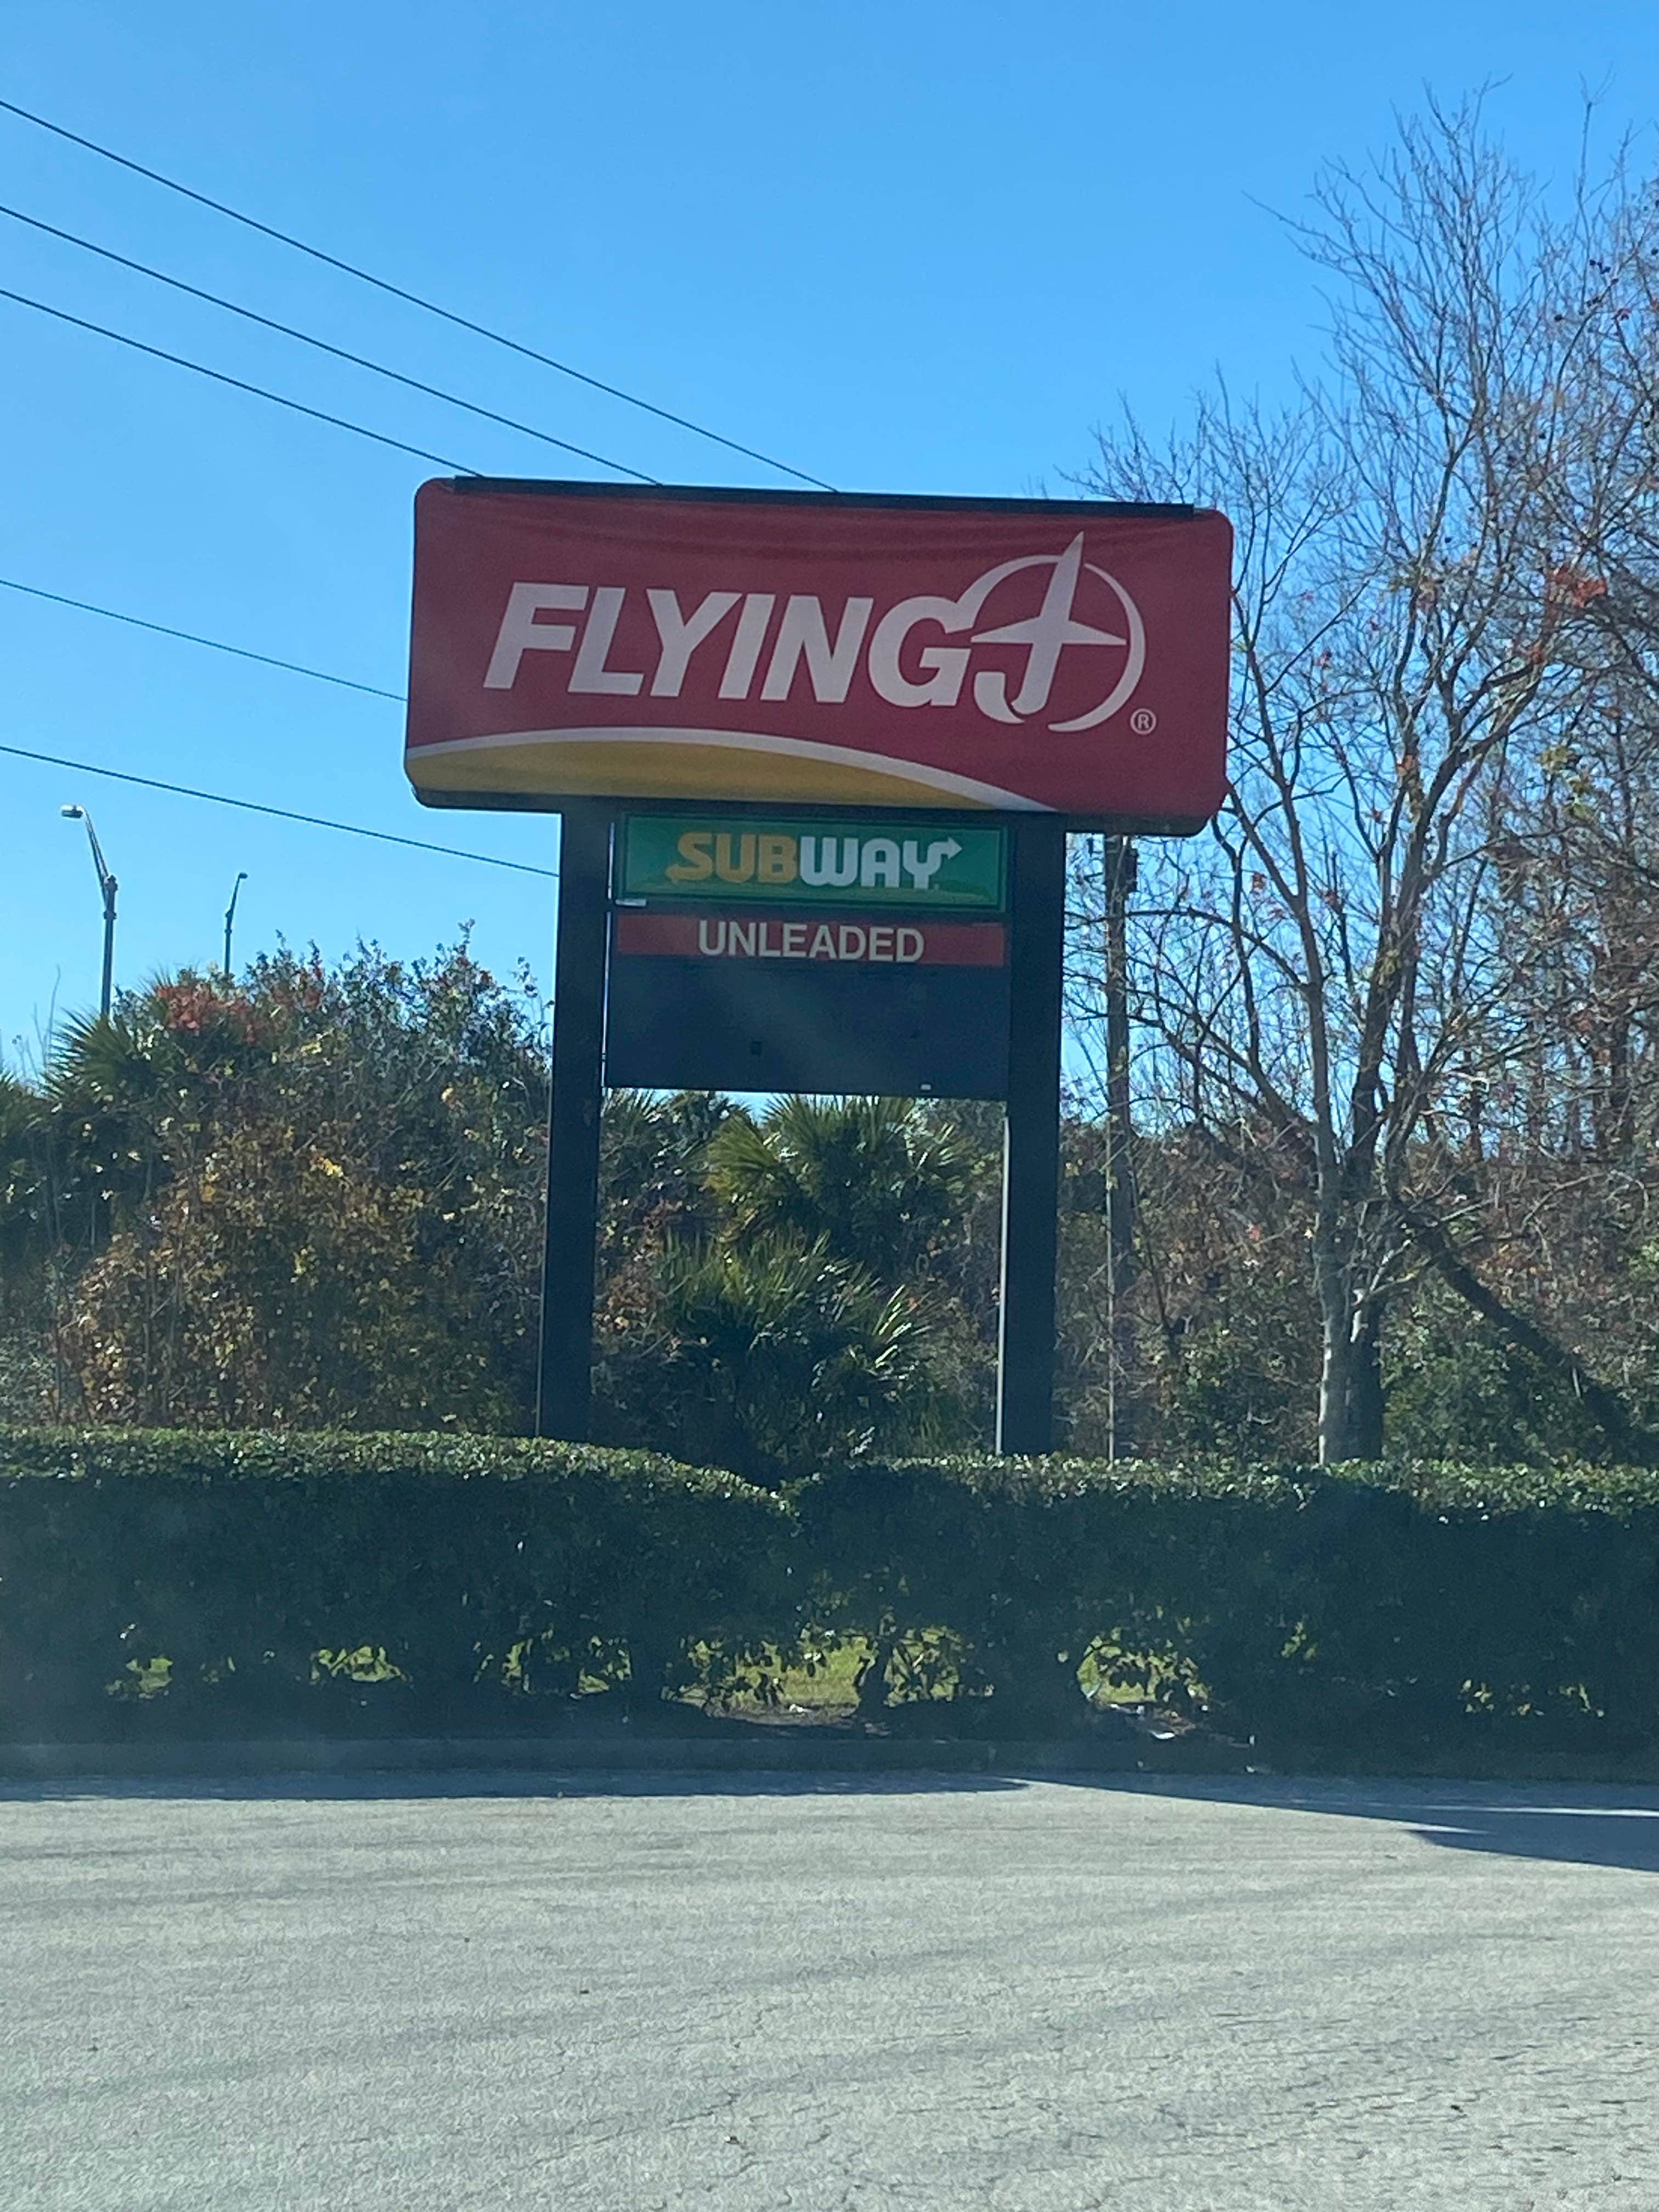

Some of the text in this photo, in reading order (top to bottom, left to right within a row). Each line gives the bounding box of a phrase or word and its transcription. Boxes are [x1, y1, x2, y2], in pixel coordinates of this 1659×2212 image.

[483, 582, 973, 708] FLYING
[666, 831, 963, 890] SUBWAY
[699, 919, 925, 962] UNLEADED
